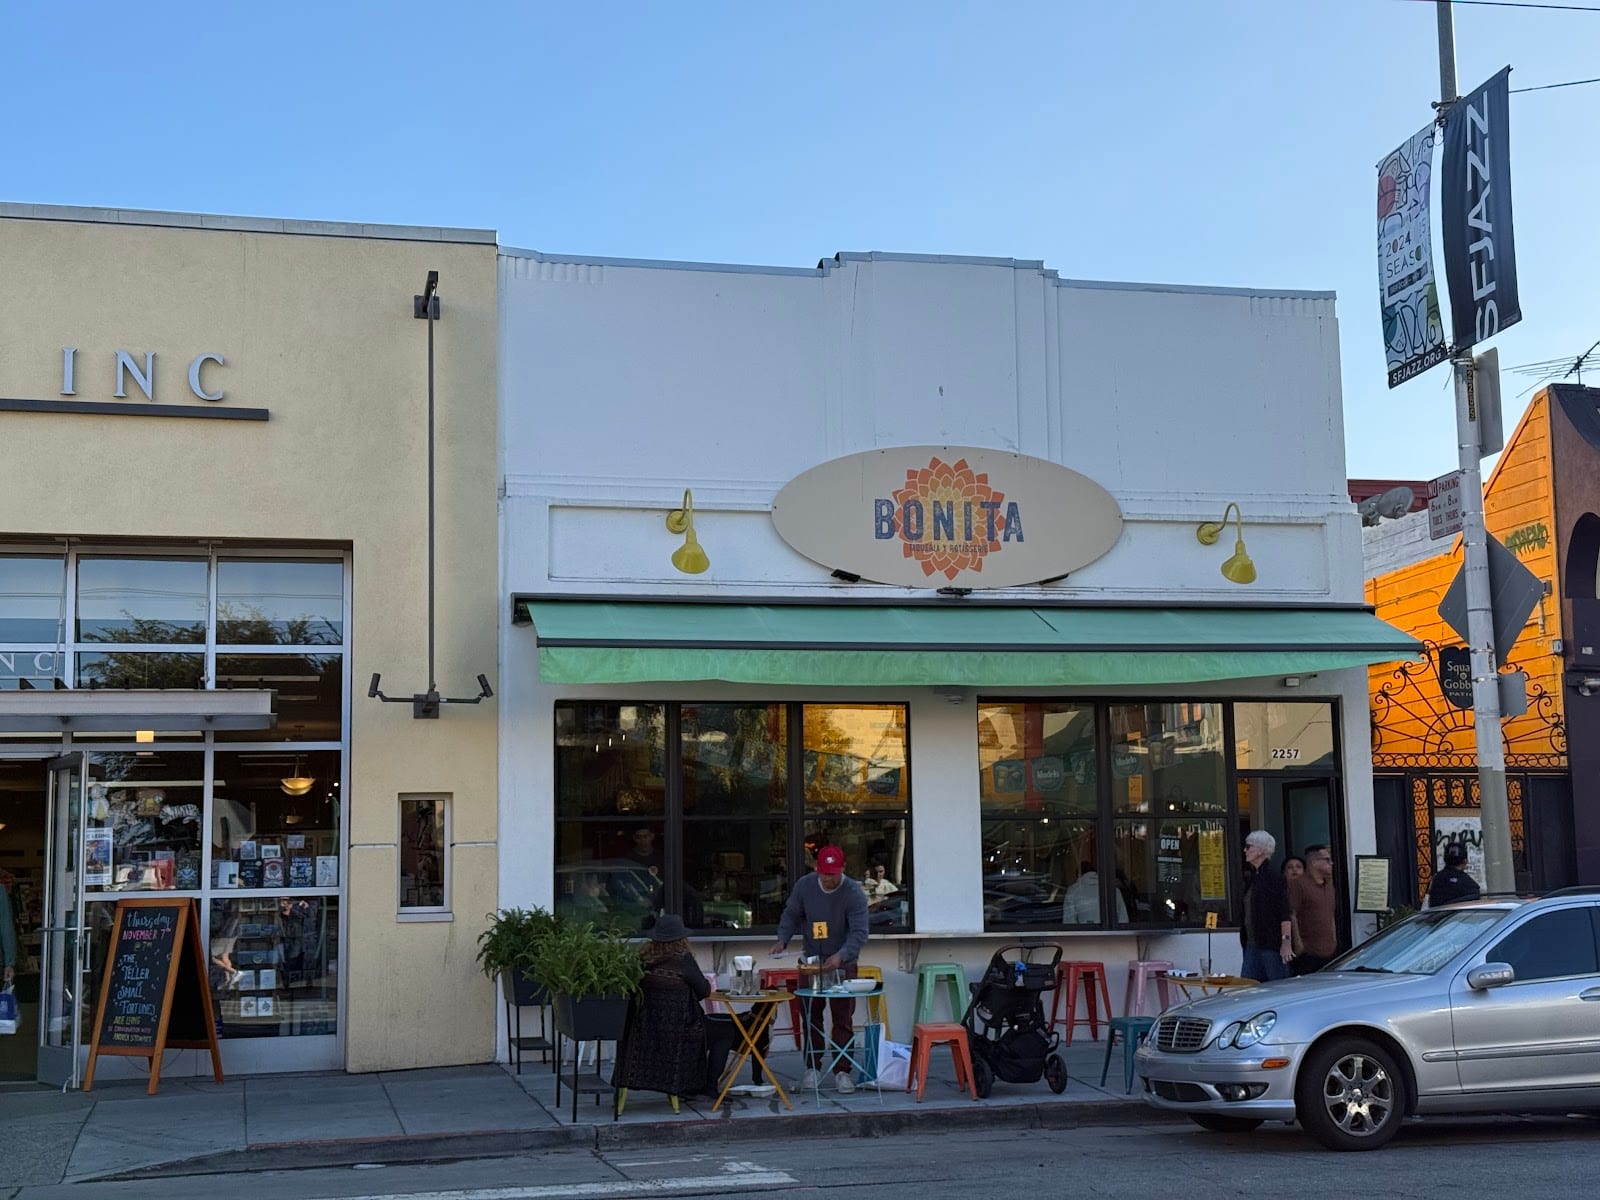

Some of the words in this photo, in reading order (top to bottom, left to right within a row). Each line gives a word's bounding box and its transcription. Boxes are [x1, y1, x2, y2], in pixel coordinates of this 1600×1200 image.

[1466, 91, 1498, 341] SFJAZZ
[60, 347, 226, 402] INC
[1392, 351, 1442, 384] SFJAZZ.ORG
[1428, 480, 1437, 498] NO
[1438, 476, 1459, 495] PARKING
[875, 498, 1024, 542] BONITA
[0, 653, 52, 672] NC
[1447, 661, 1470, 676] Squa
[1444, 679, 1471, 690] Gobb
[1272, 748, 1299, 759] 2257
[1160, 839, 1180, 850] OPEN
[122, 929, 158, 940] NOVEMBER
[122, 953, 136, 963] THE
[121, 965, 150, 980] TELLER
[117, 985, 143, 999] SMALL
